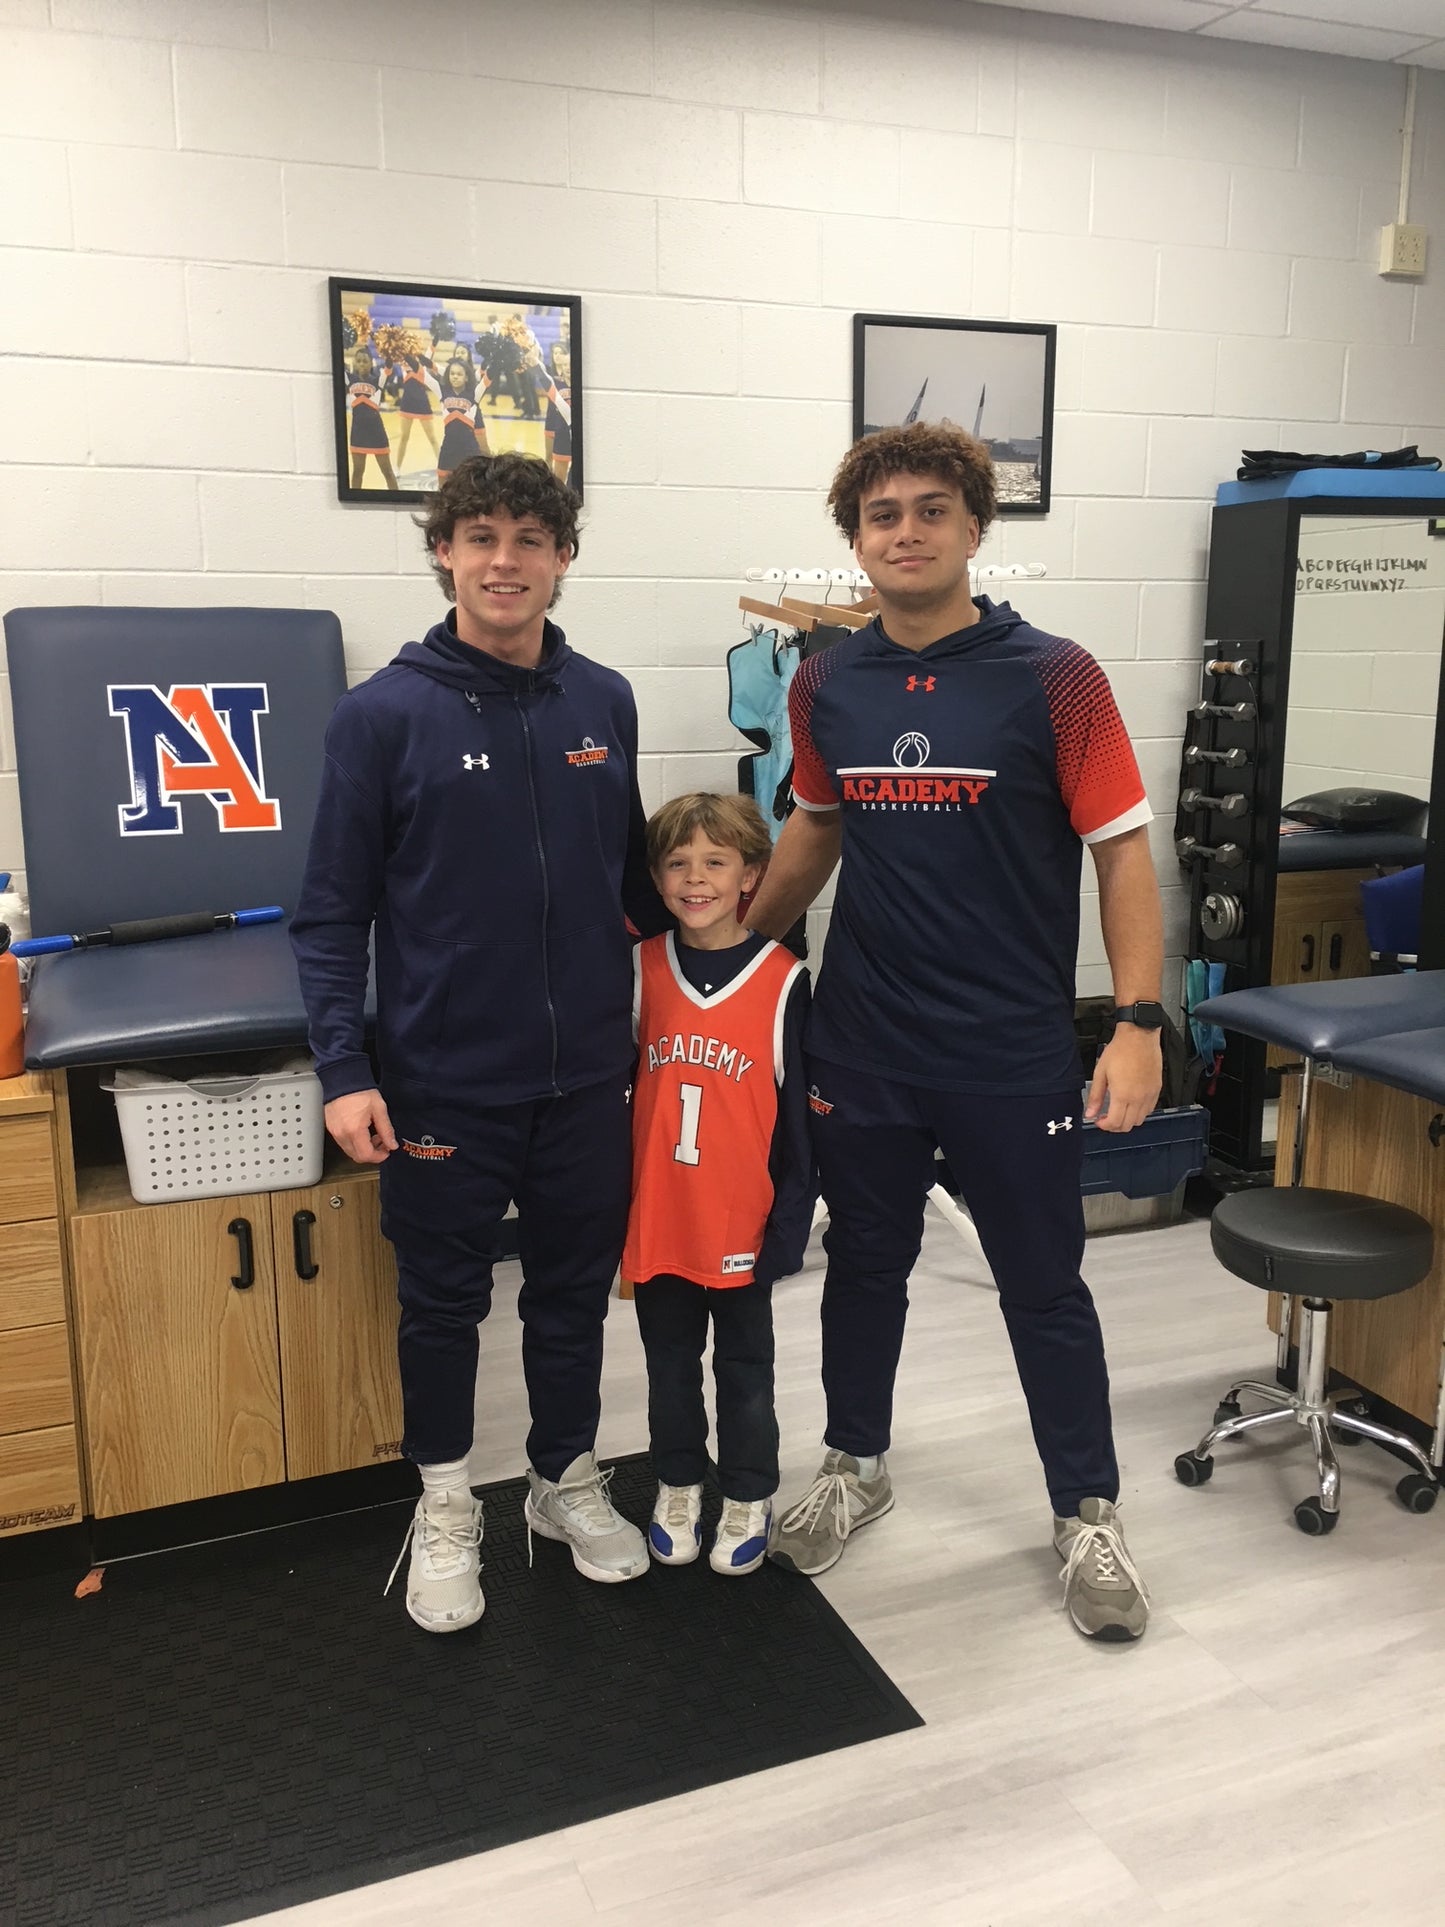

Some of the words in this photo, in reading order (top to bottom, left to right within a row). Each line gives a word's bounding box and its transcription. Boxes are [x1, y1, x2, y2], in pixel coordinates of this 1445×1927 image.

[567, 750, 608, 764] ACADEMY
[843, 779, 989, 804] ACADEMY
[862, 803, 962, 812] BASKETBALL
[648, 1033, 755, 1083] ACADEMY
[673, 1082, 704, 1167] 1
[402, 1141, 455, 1157] ACADEMY
